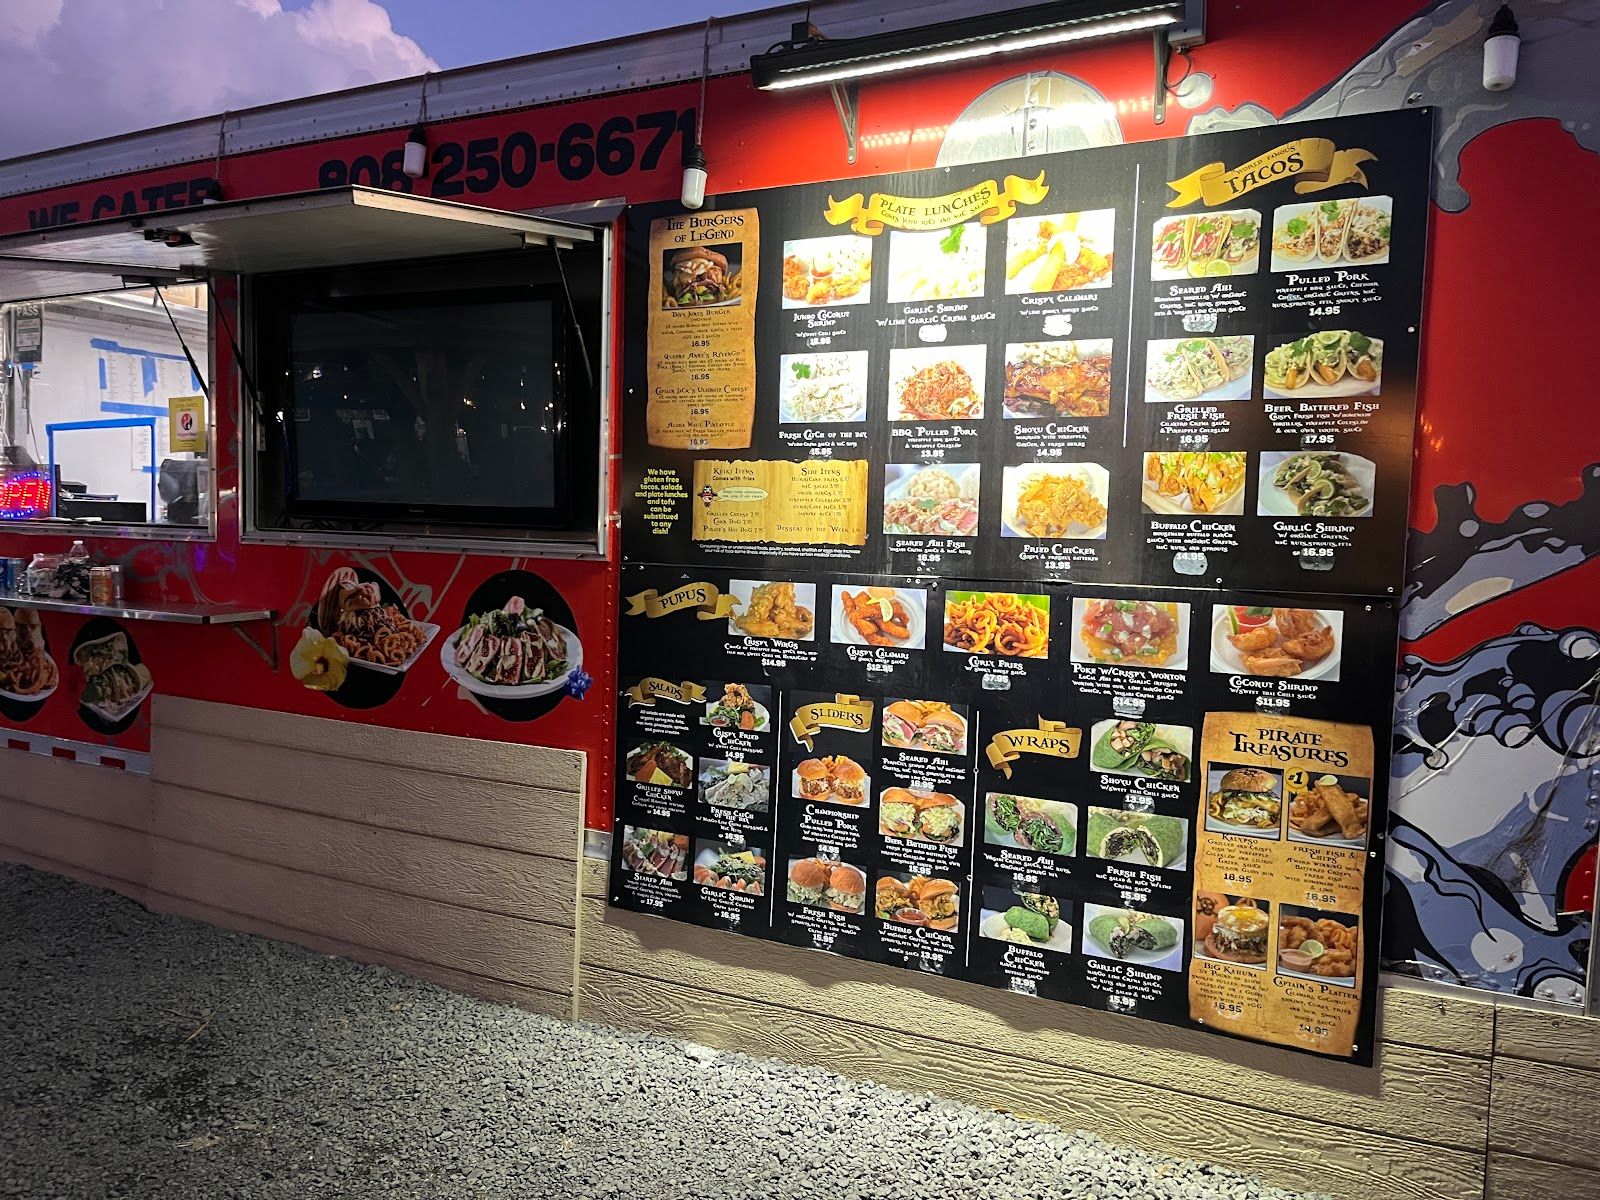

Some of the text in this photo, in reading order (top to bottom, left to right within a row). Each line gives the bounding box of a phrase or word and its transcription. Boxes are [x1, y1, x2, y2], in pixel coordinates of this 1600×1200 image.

[1236, 146, 1296, 174] WORLD FAMOUS
[1224, 152, 1304, 194] TACOS
[880, 187, 991, 216] PLATE LUNCHES
[664, 215, 744, 230] THE BURGERS
[674, 229, 734, 242] OF LEGEND
[1285, 271, 1369, 285] PULLED PORK
[1170, 285, 1206, 296] SEARED
[1022, 294, 1098, 305] CRISPY CALAMARI
[16, 305, 39, 317] PASS
[903, 304, 968, 314] GARLIC SHRIMP
[1309, 306, 1340, 316] 14.95
[794, 310, 850, 322] JUMBO COCONUT
[1174, 404, 1217, 413] GRILLED
[1264, 402, 1379, 412] BEER BATTERED FISH
[1167, 412, 1224, 421] FRESH FISH
[892, 426, 978, 437] BBQ PULLED PORK
[1014, 423, 1090, 435] SHOYU CHICKEN
[779, 431, 801, 440] FRESH
[1180, 435, 1209, 443] 16.95
[1305, 435, 1334, 443] 17.95
[1151, 520, 1236, 532] BUFFALO CHICKEN
[1273, 522, 1355, 533] GARLIC SHRIMP
[947, 540, 965, 549] FISH
[1024, 544, 1095, 555] FRIED CHICKEN
[1302, 548, 1334, 556] 16.95
[658, 589, 706, 608] PUPUS
[744, 636, 798, 650] CRISPY WINGS
[847, 646, 874, 657] CRISPY
[968, 656, 1023, 670] CURLY FRIES
[1070, 662, 1096, 674] POKE
[1148, 671, 1186, 682] WONTON
[1229, 675, 1318, 692] COCONUT SHRIMP
[649, 682, 682, 700] SALADS
[1256, 696, 1290, 707] $11.95
[811, 709, 863, 725] SLIDERS
[1257, 728, 1323, 745] PIRATE
[1002, 735, 1070, 754] WRAPS
[1229, 731, 1348, 767] TREASURES
[899, 752, 928, 763] SEARED
[1100, 775, 1180, 792] SHOYU CHICKEN
[1288, 772, 1302, 784] #1
[1125, 795, 1152, 805] 13.95
[806, 804, 859, 819] CHAMPIONSHIP
[802, 814, 858, 831] PULLED PORK
[1222, 833, 1258, 845] KALYPSO
[1000, 850, 1032, 862] SEARED
[1293, 846, 1320, 855] FRESH
[1107, 866, 1161, 882] FRESH FISH
[1224, 873, 1252, 883] 18.95
[1120, 891, 1147, 902] 15.95
[803, 907, 846, 921] FRESH FISH
[883, 922, 952, 943] BUFFALO CHICKEN
[1008, 945, 1043, 958] BUFFALO
[1004, 952, 1045, 968] CHICKEN
[1087, 960, 1162, 981] GARLIC SHRIMP
[1204, 962, 1258, 978] BIG KAHUNA
[1273, 976, 1360, 1000] CAPTAIN'S PLATTER
